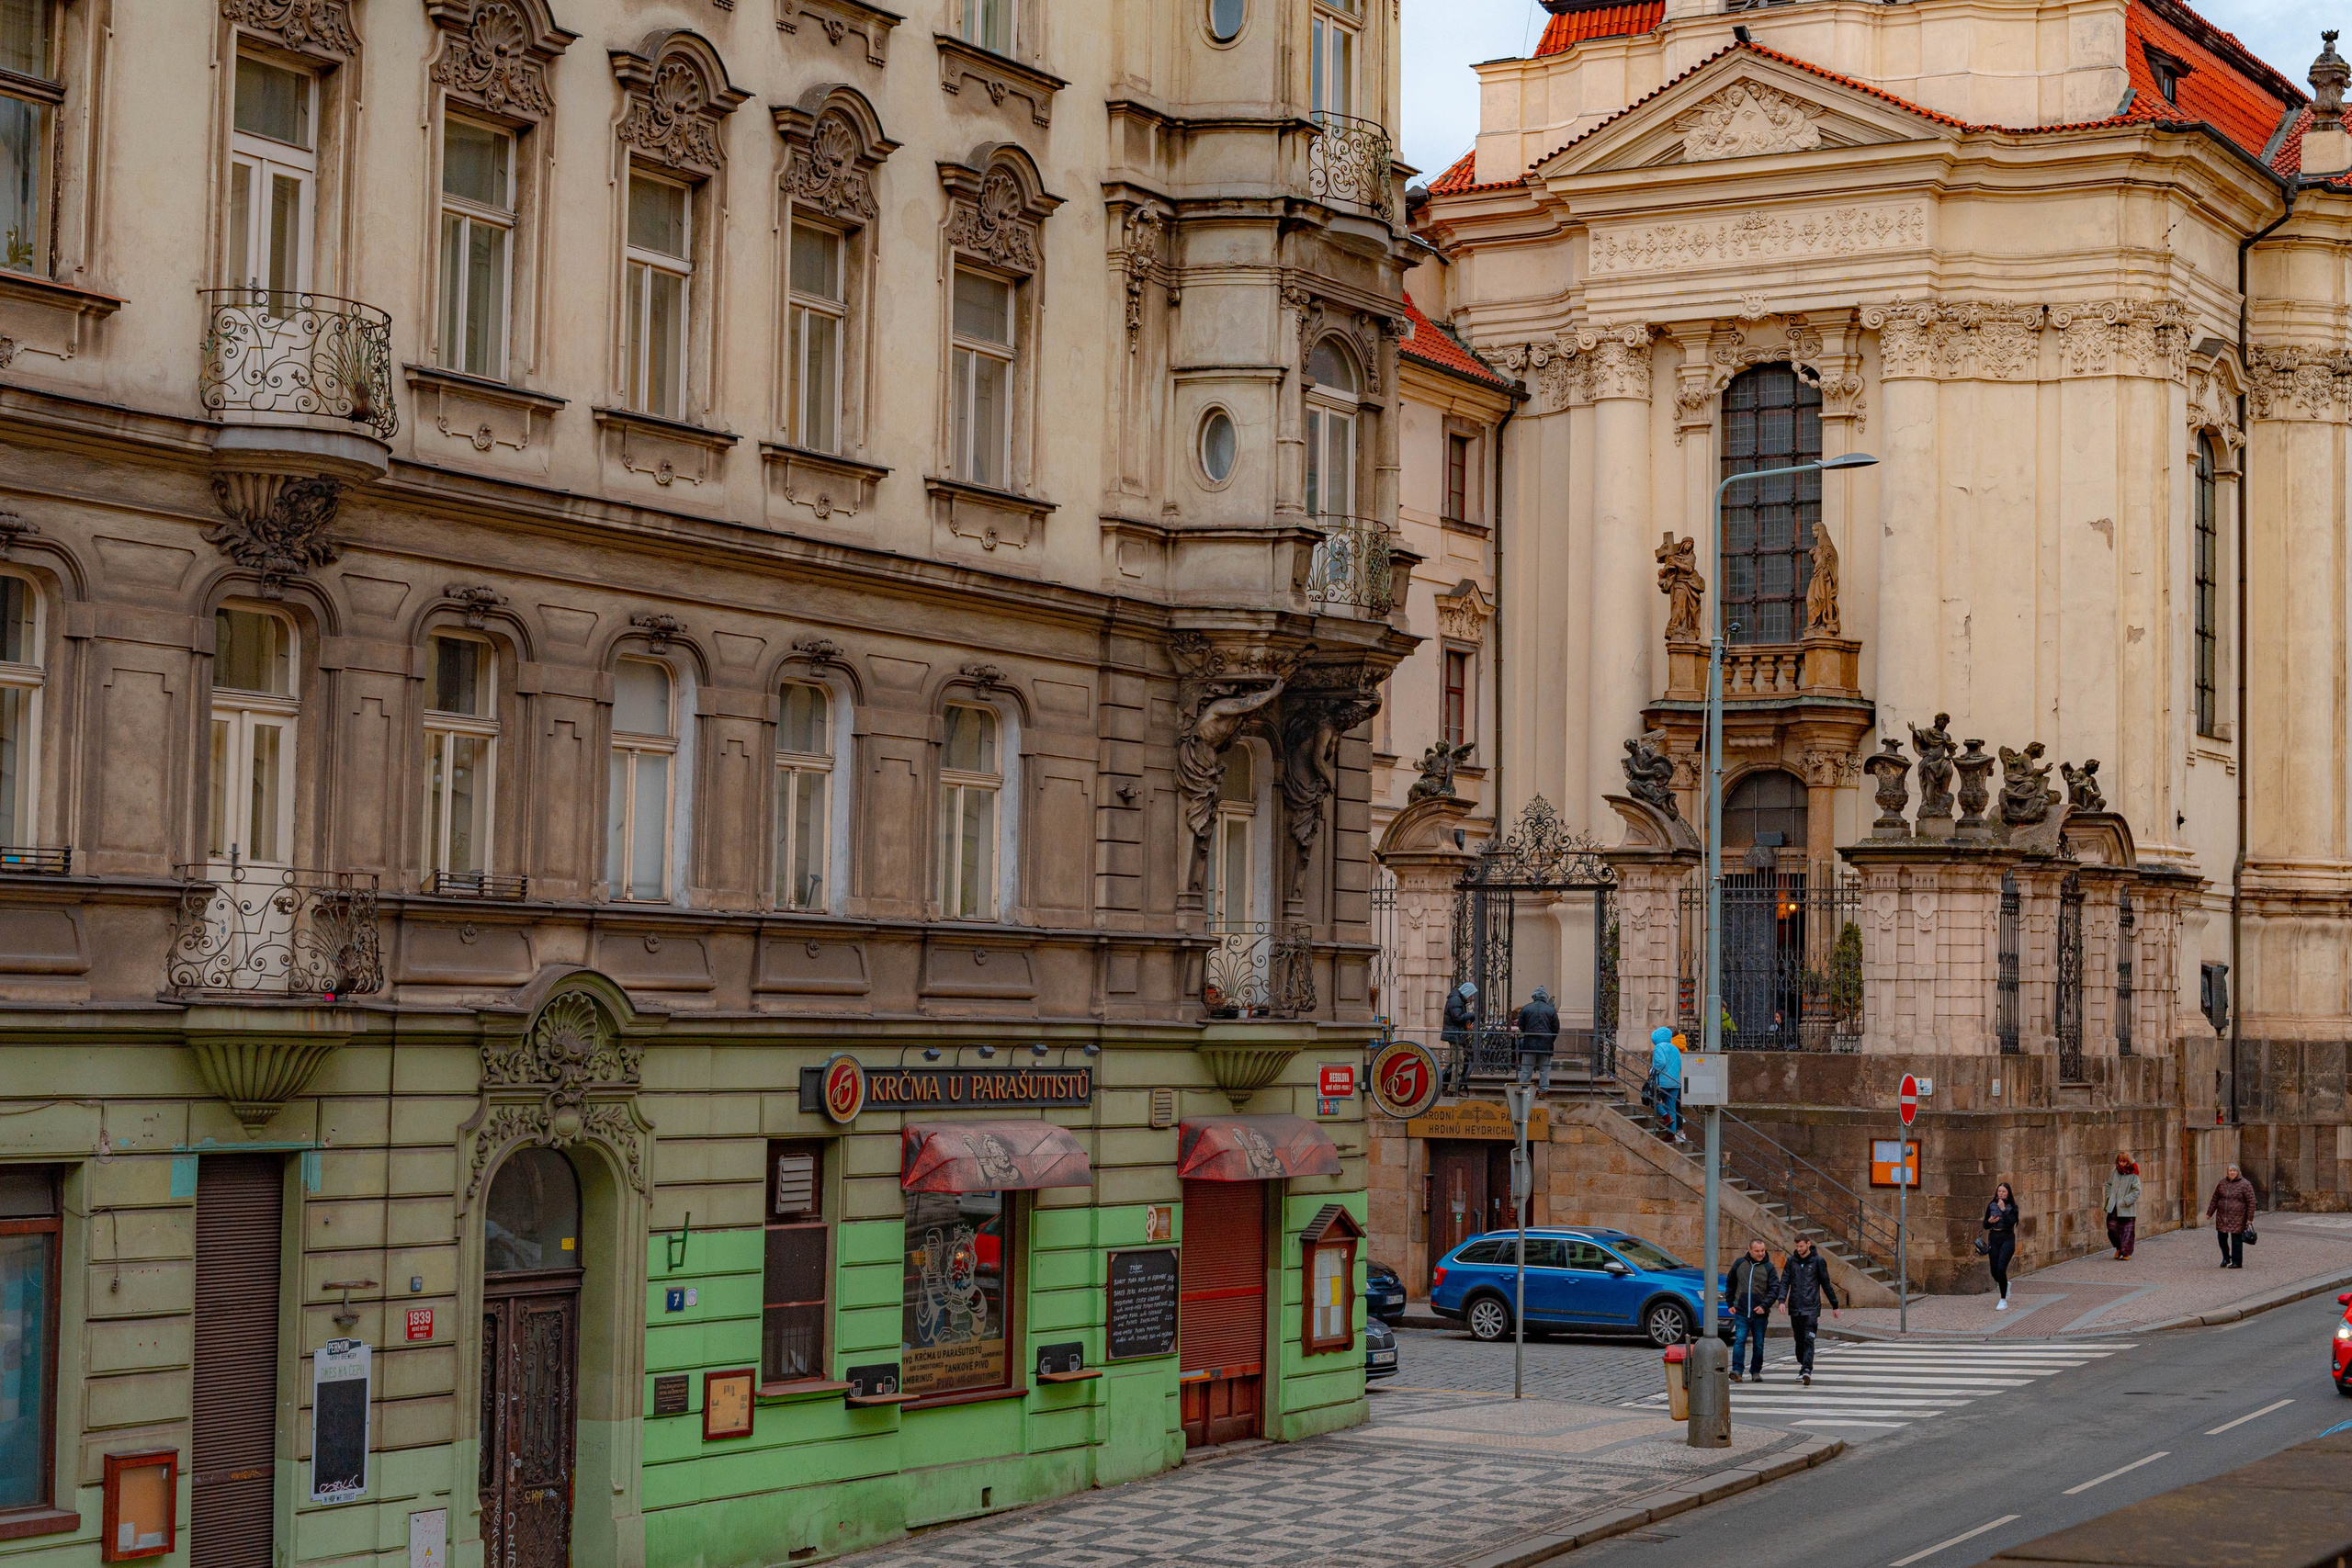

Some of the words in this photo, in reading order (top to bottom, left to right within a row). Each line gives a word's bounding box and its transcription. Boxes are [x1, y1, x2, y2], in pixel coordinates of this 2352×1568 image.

[1329, 1073, 1350, 1082] RESSLOVA
[870, 1070, 941, 1101] KRČMA
[948, 1075, 963, 1100] U
[970, 1069, 1090, 1100] PARAŠUTISTŮ
[1378, 1095, 1428, 1113] GAMBRINUS
[1501, 1111, 1542, 1123] PANÍK
[1428, 1122, 1460, 1134] HRDINŮ
[673, 1293, 680, 1306] 7
[410, 1311, 431, 1325] 1939
[914, 1352, 935, 1361] KRČMA
[937, 1350, 942, 1359] U
[943, 1344, 982, 1358] PARAŠUTISTŮ
[349, 1363, 365, 1376] ČEPU
[917, 1362, 944, 1371] CONDITIONED
[944, 1359, 973, 1373] TANKOVÉ
[975, 1359, 989, 1369] PIVO
[902, 1373, 933, 1385] AMBRINUS
[937, 1376, 954, 1389] PIVO
